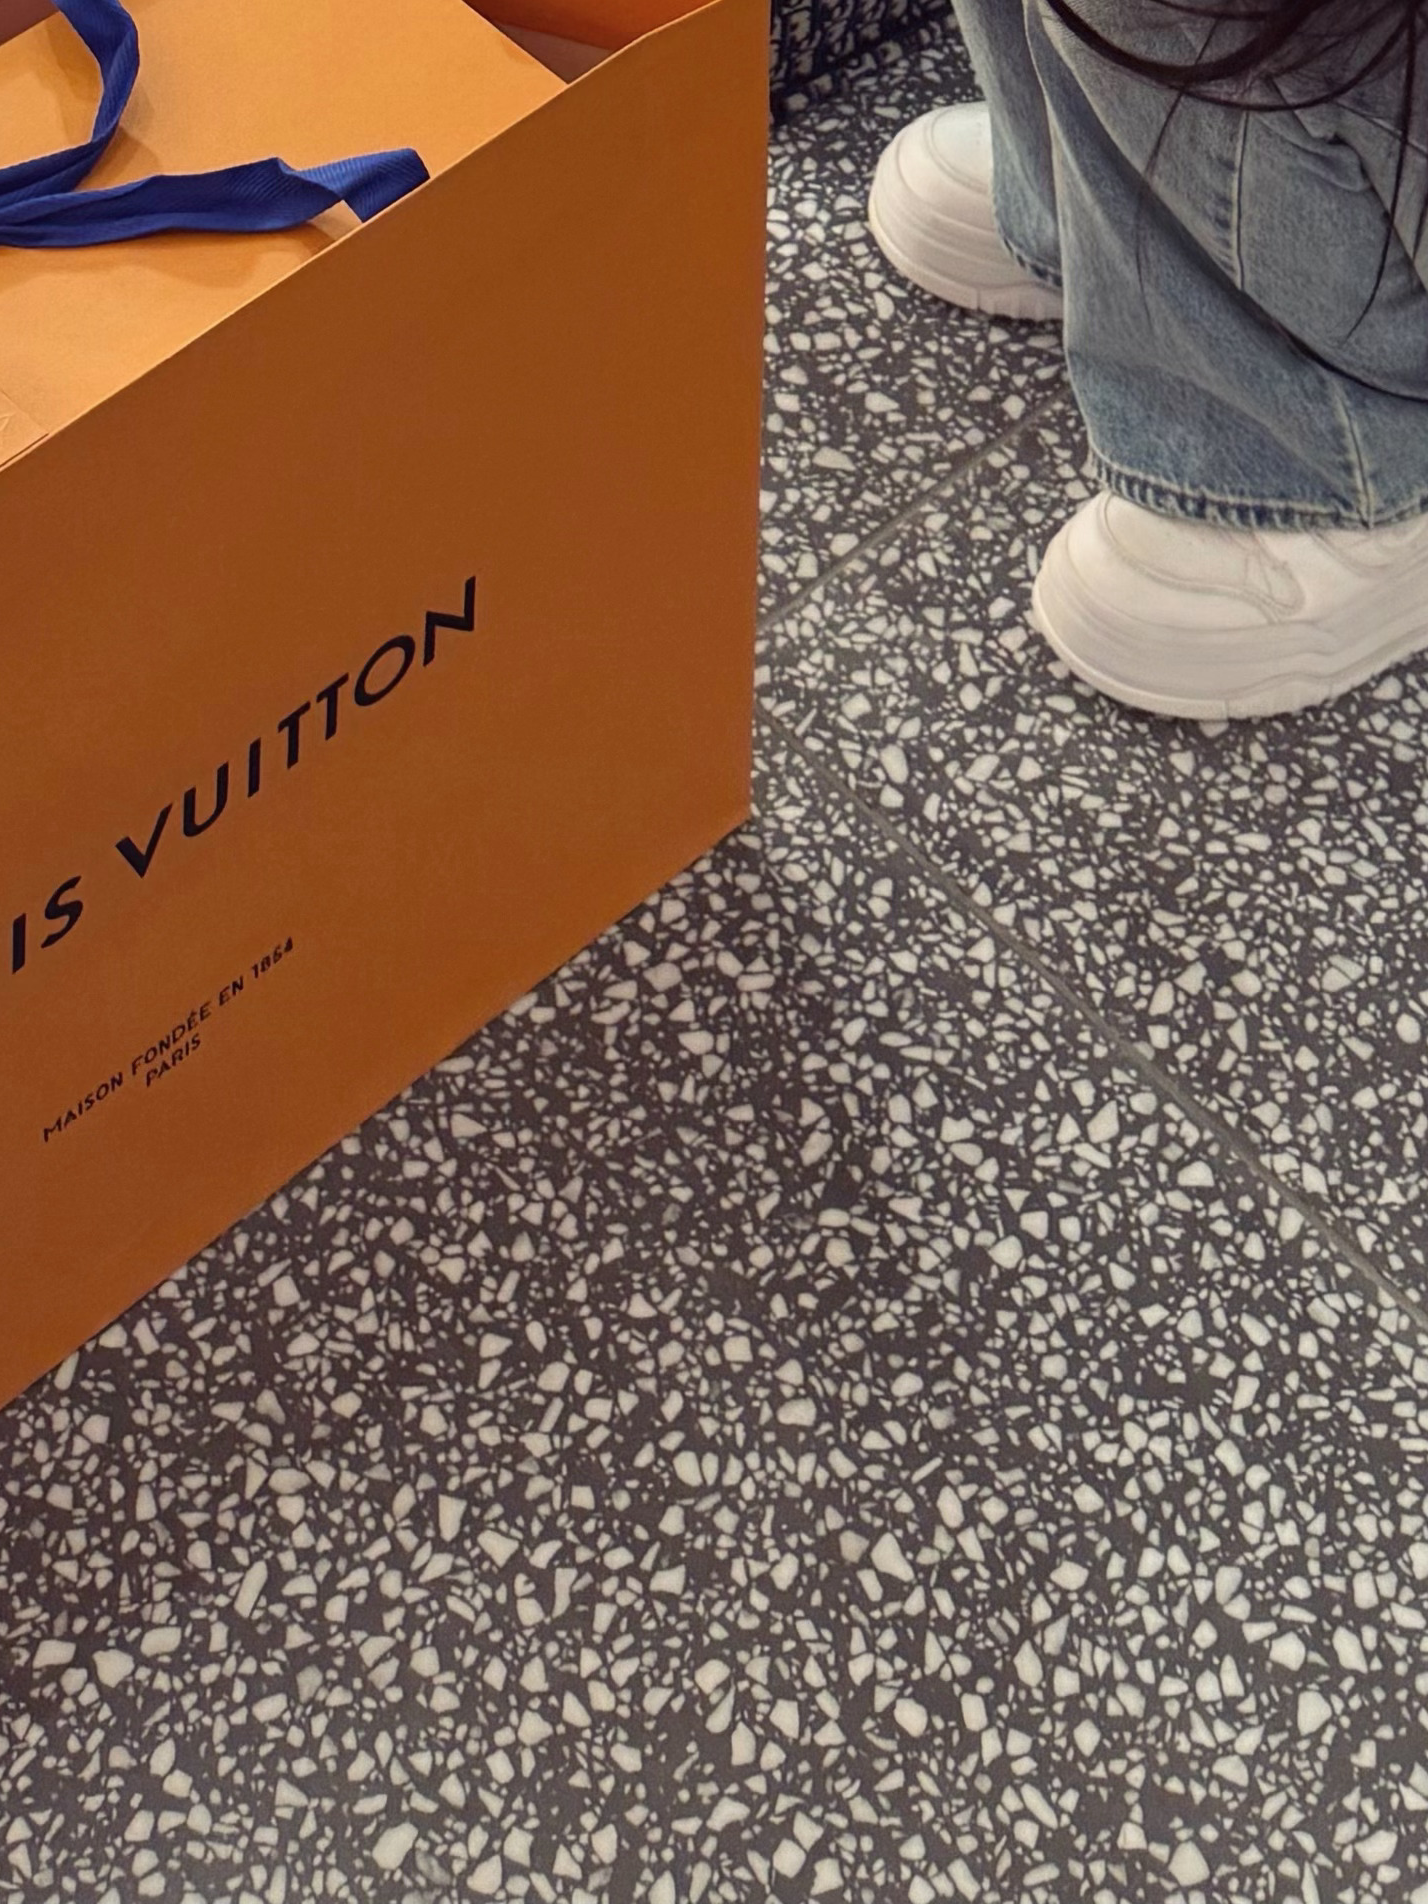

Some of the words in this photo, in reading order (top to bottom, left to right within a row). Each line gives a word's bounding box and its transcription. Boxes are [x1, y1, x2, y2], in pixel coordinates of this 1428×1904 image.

[115, 576, 477, 878] VUITTON
[43, 1072, 123, 1143] MAISON
[131, 1001, 212, 1076] FONDÉE
[218, 976, 245, 1007] EN
[145, 1033, 202, 1088] PARIS
